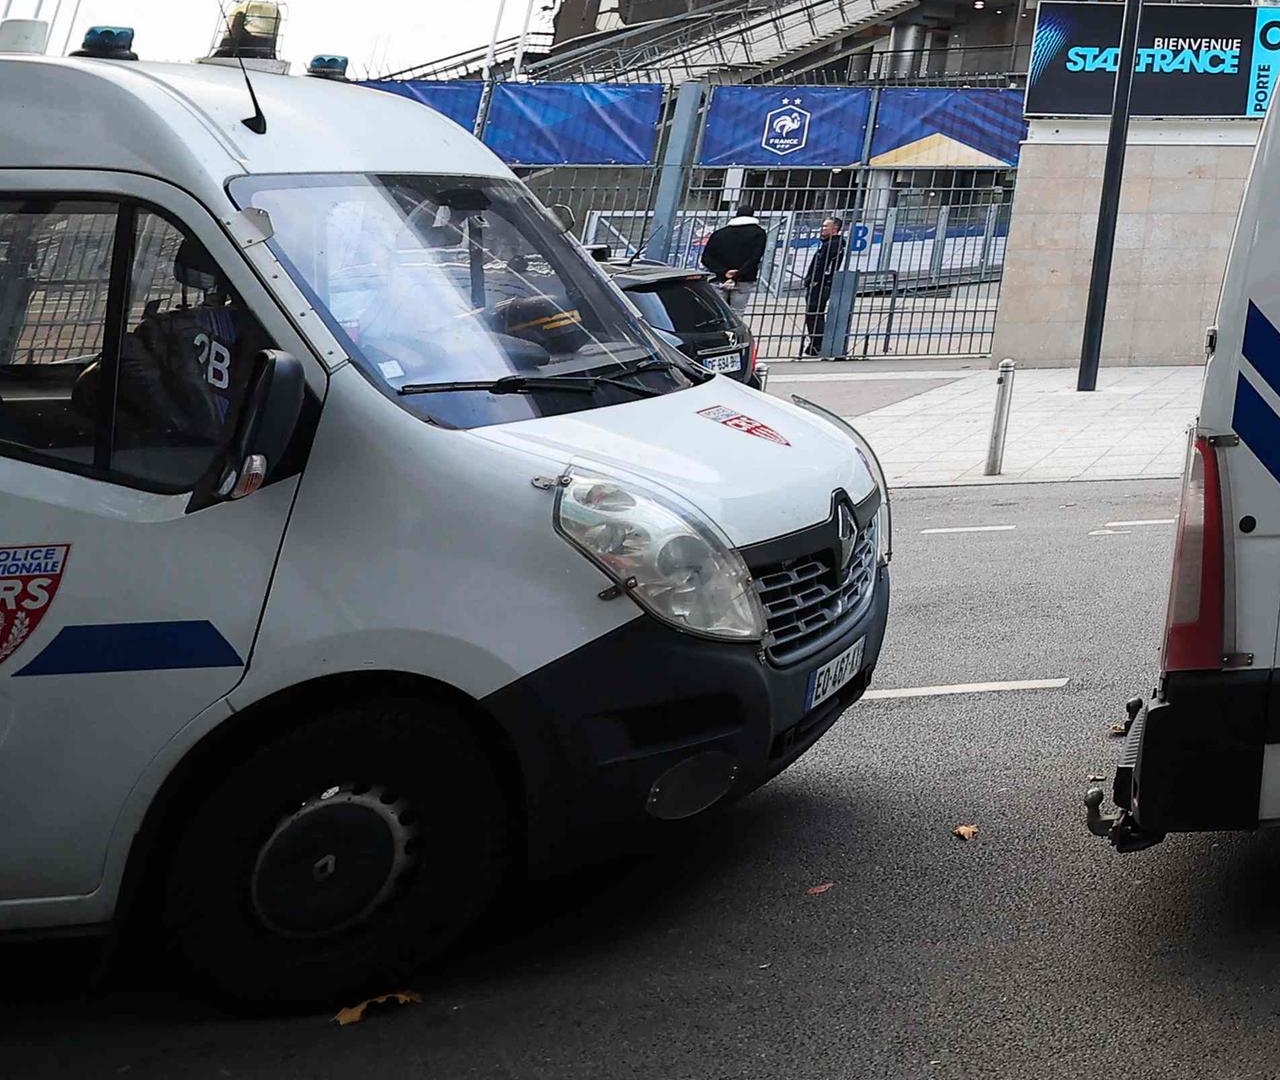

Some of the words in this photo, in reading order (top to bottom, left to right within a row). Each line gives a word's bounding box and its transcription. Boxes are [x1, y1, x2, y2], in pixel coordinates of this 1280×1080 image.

[1154, 37, 1241, 51] BIENVENUE
[1065, 46, 1240, 74] STADFRANCE
[1253, 63, 1271, 112] PORTE
[0, 549, 55, 562] OLICE
[0, 578, 53, 610] RS
